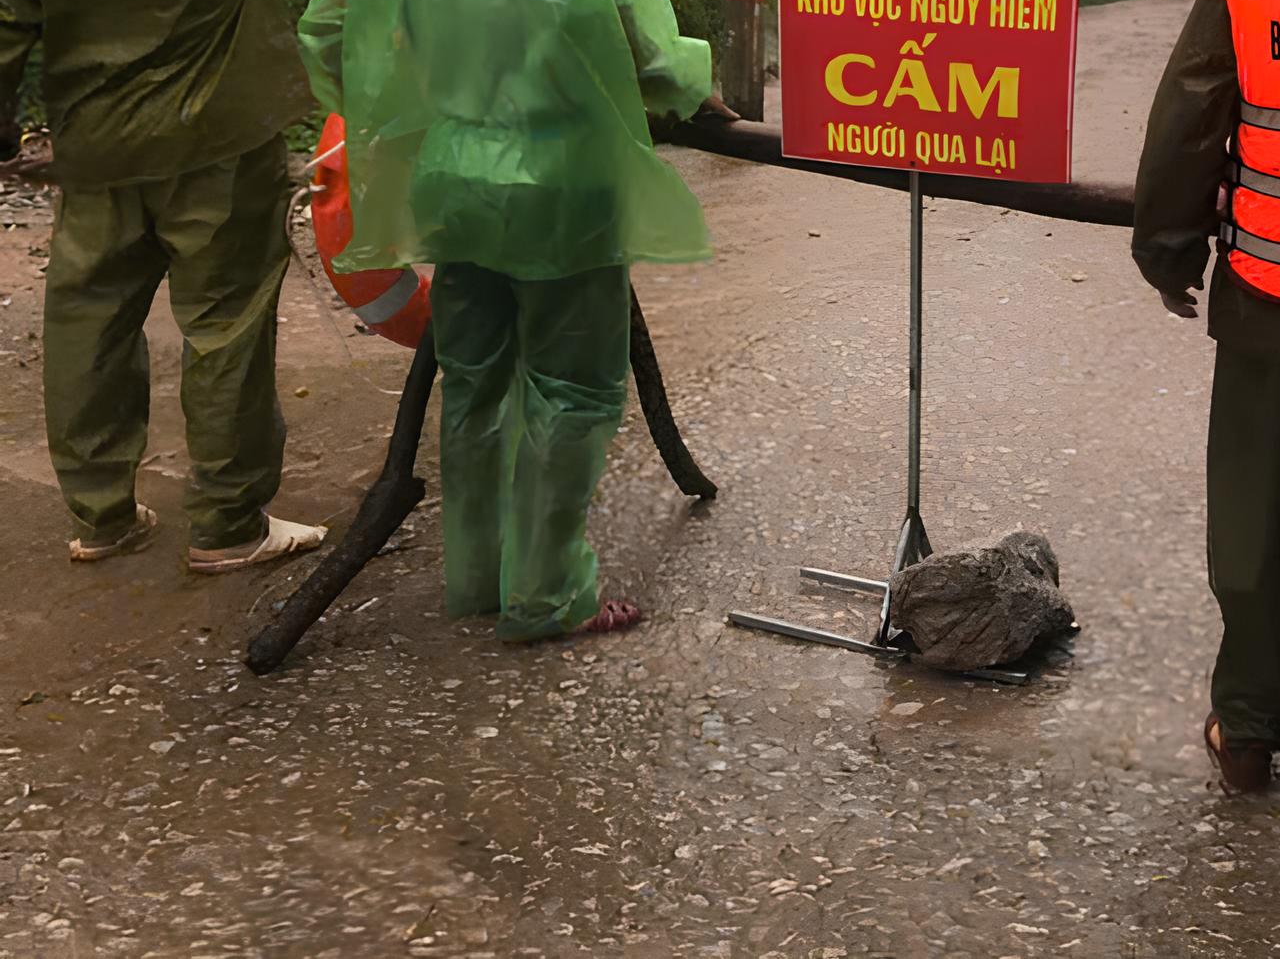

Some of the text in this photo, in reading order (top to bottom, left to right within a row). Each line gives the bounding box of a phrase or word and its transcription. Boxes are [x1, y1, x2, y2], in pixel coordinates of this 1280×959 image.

[824, 32, 1020, 120] CẤM
[827, 121, 1016, 175] NGƯỜI QUA LẠI
